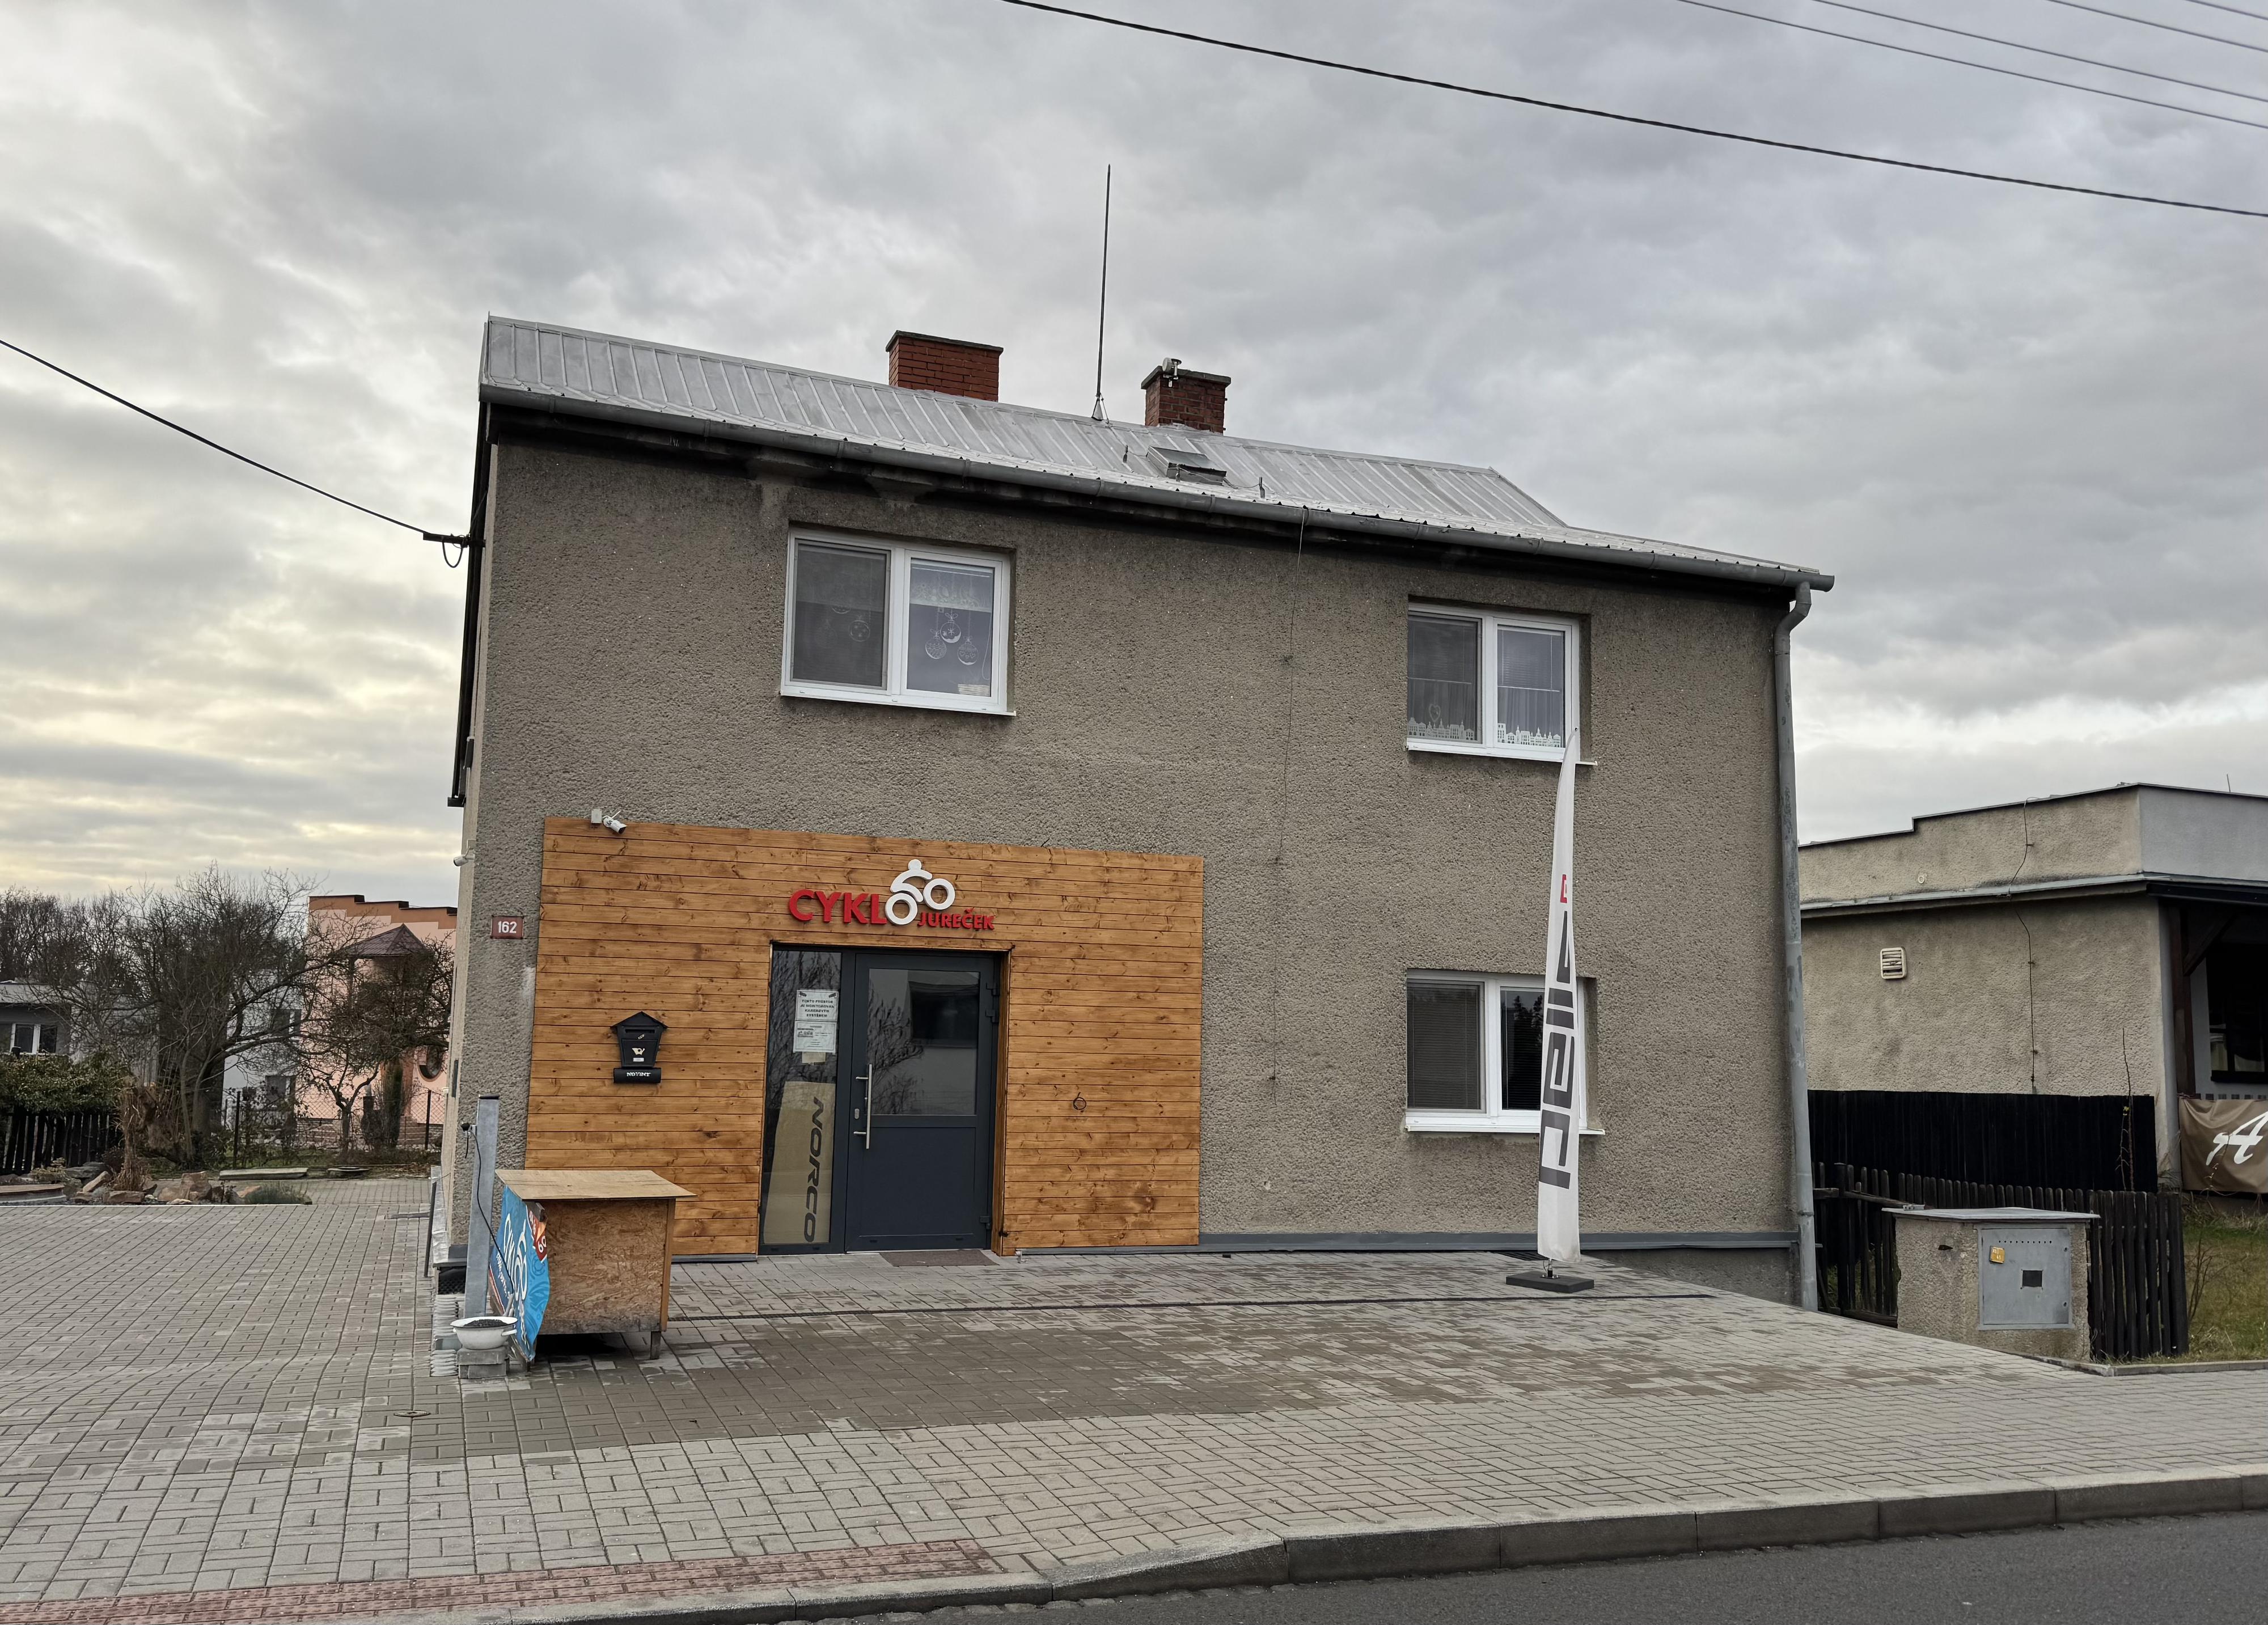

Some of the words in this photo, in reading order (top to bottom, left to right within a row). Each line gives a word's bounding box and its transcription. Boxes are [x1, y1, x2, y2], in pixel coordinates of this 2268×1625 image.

[498, 921, 517, 934] 162
[918, 908, 994, 930] JUREČEK
[803, 1097, 823, 1243] NORCO
